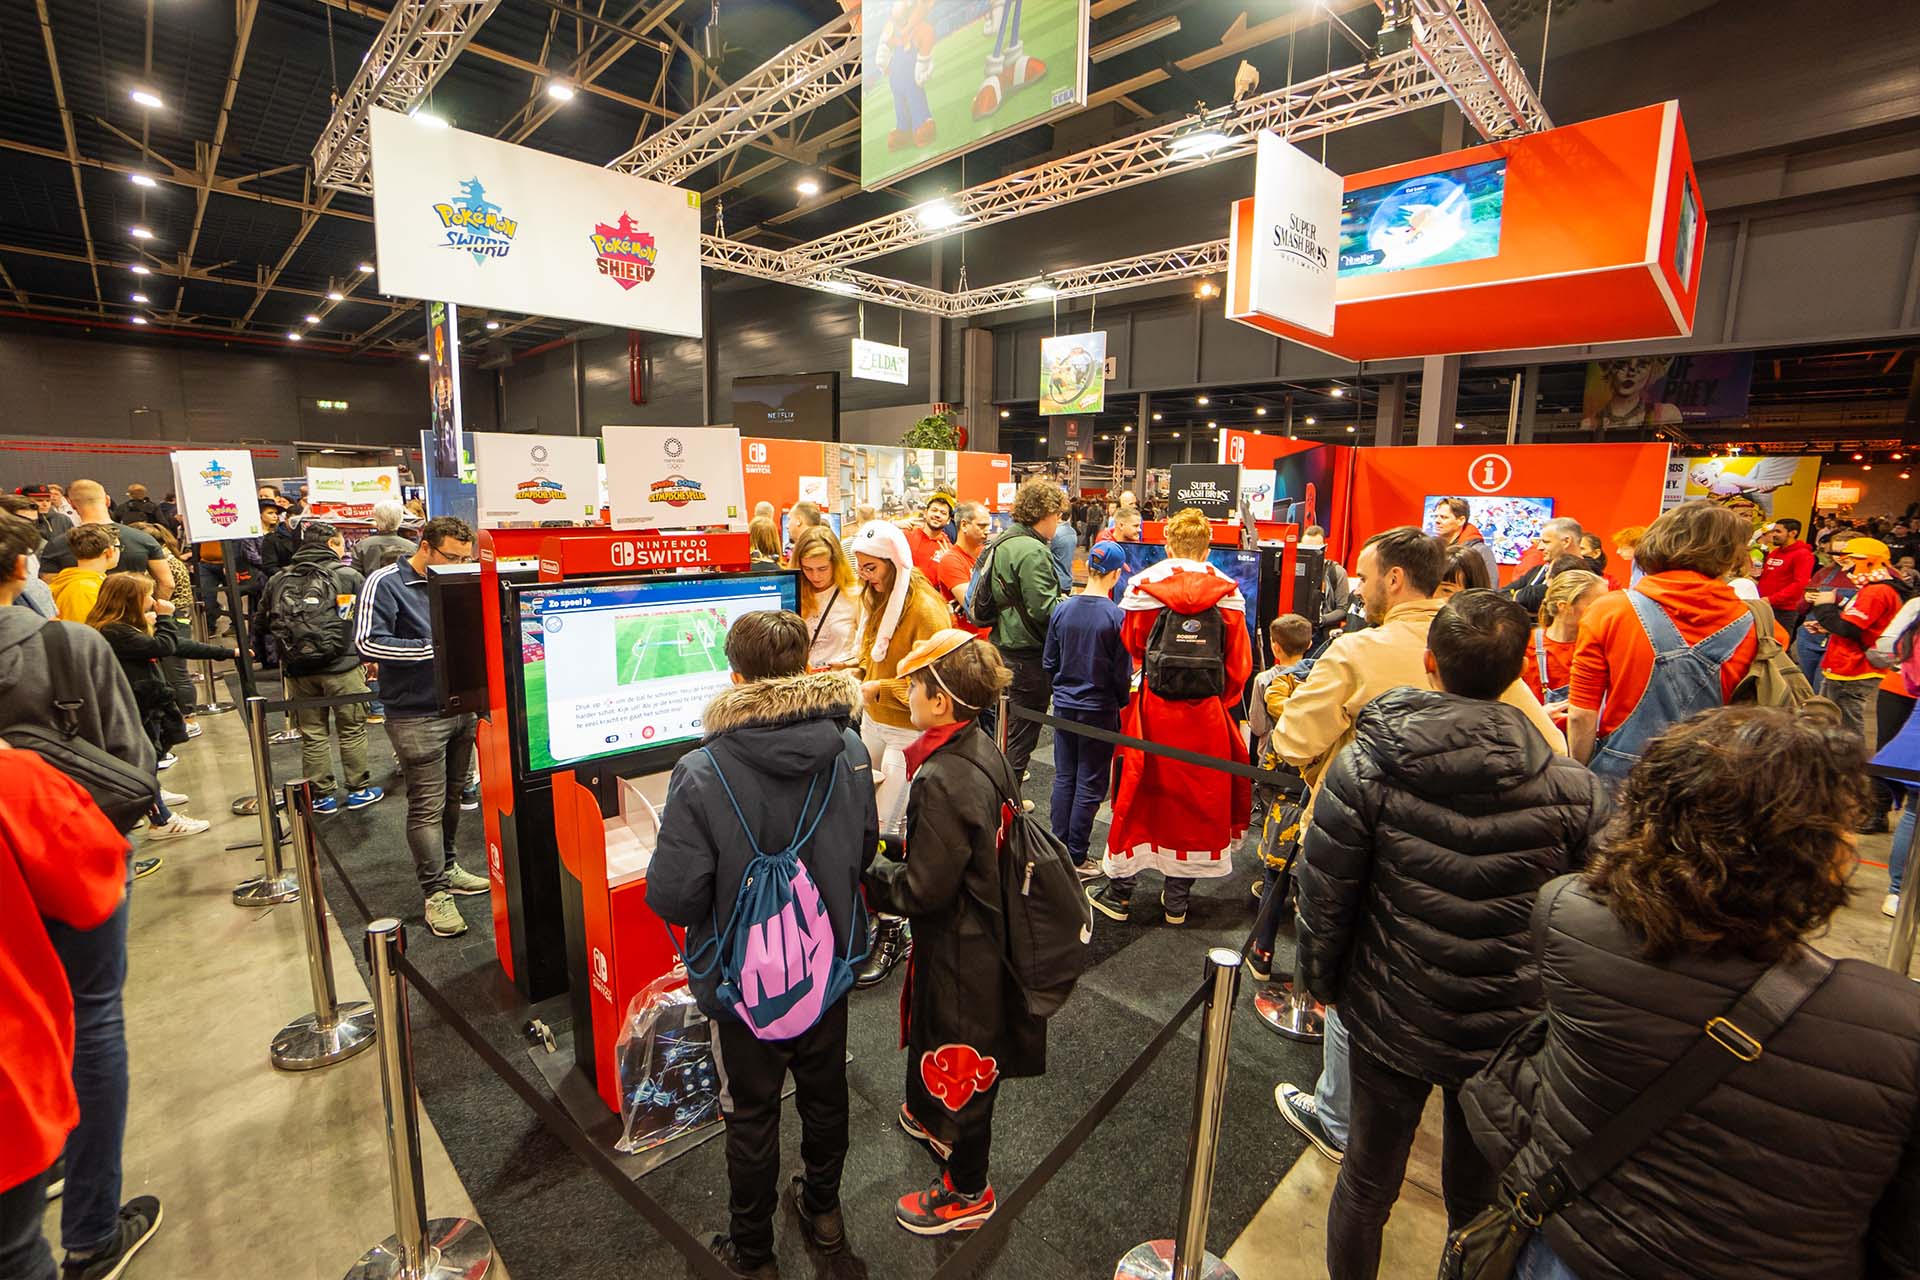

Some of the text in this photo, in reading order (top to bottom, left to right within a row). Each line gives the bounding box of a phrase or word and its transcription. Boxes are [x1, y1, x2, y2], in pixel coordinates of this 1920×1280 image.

[1290, 213, 1316, 241] SUPER
[446, 231, 510, 258] SWORD
[1273, 224, 1304, 252] SMASH
[596, 257, 656, 282] SHIELD
[1668, 463, 1684, 473] RDS
[1190, 481, 1217, 490] SUPER
[1177, 489, 1204, 500] SMASH
[637, 539, 707, 549] NINTENDO
[637, 548, 707, 565] SWITCH
[549, 598, 591, 608] Zo speel je
